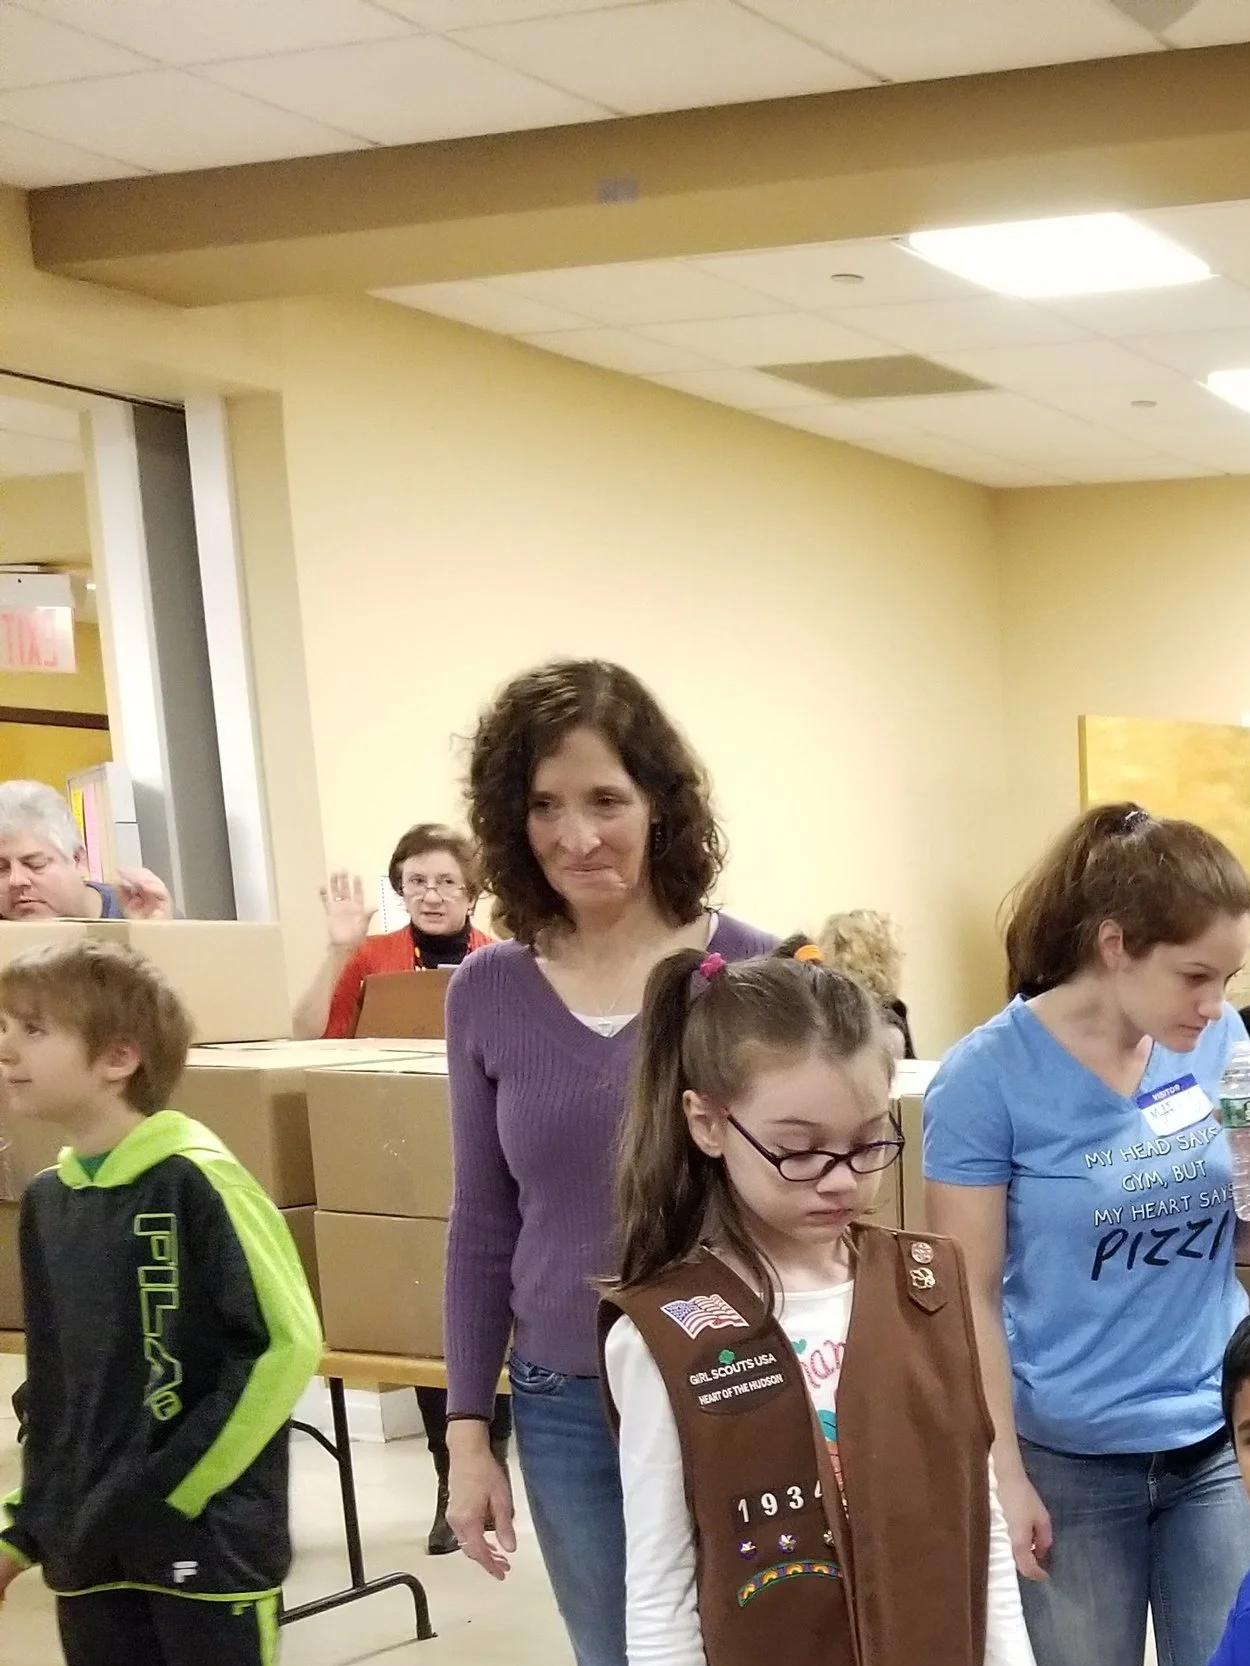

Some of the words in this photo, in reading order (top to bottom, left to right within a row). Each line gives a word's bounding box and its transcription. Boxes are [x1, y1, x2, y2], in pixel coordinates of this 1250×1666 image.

[1084, 1150, 1113, 1169] MY
[1120, 1138, 1171, 1162] HEAD
[1122, 1172, 1168, 1192] GYM,
[1172, 1160, 1207, 1183] BUT
[1094, 1207, 1123, 1227] MY
[1132, 1195, 1191, 1221] HEART
[134, 1212, 184, 1406] FILA
[689, 1372, 713, 1385] GIRL
[711, 1358, 755, 1380] SCOUTS
[754, 1353, 777, 1366] USA
[698, 1391, 722, 1405] HEART
[722, 1387, 734, 1399] OF
[733, 1382, 750, 1396] THE
[749, 1373, 784, 1391] HUDSON
